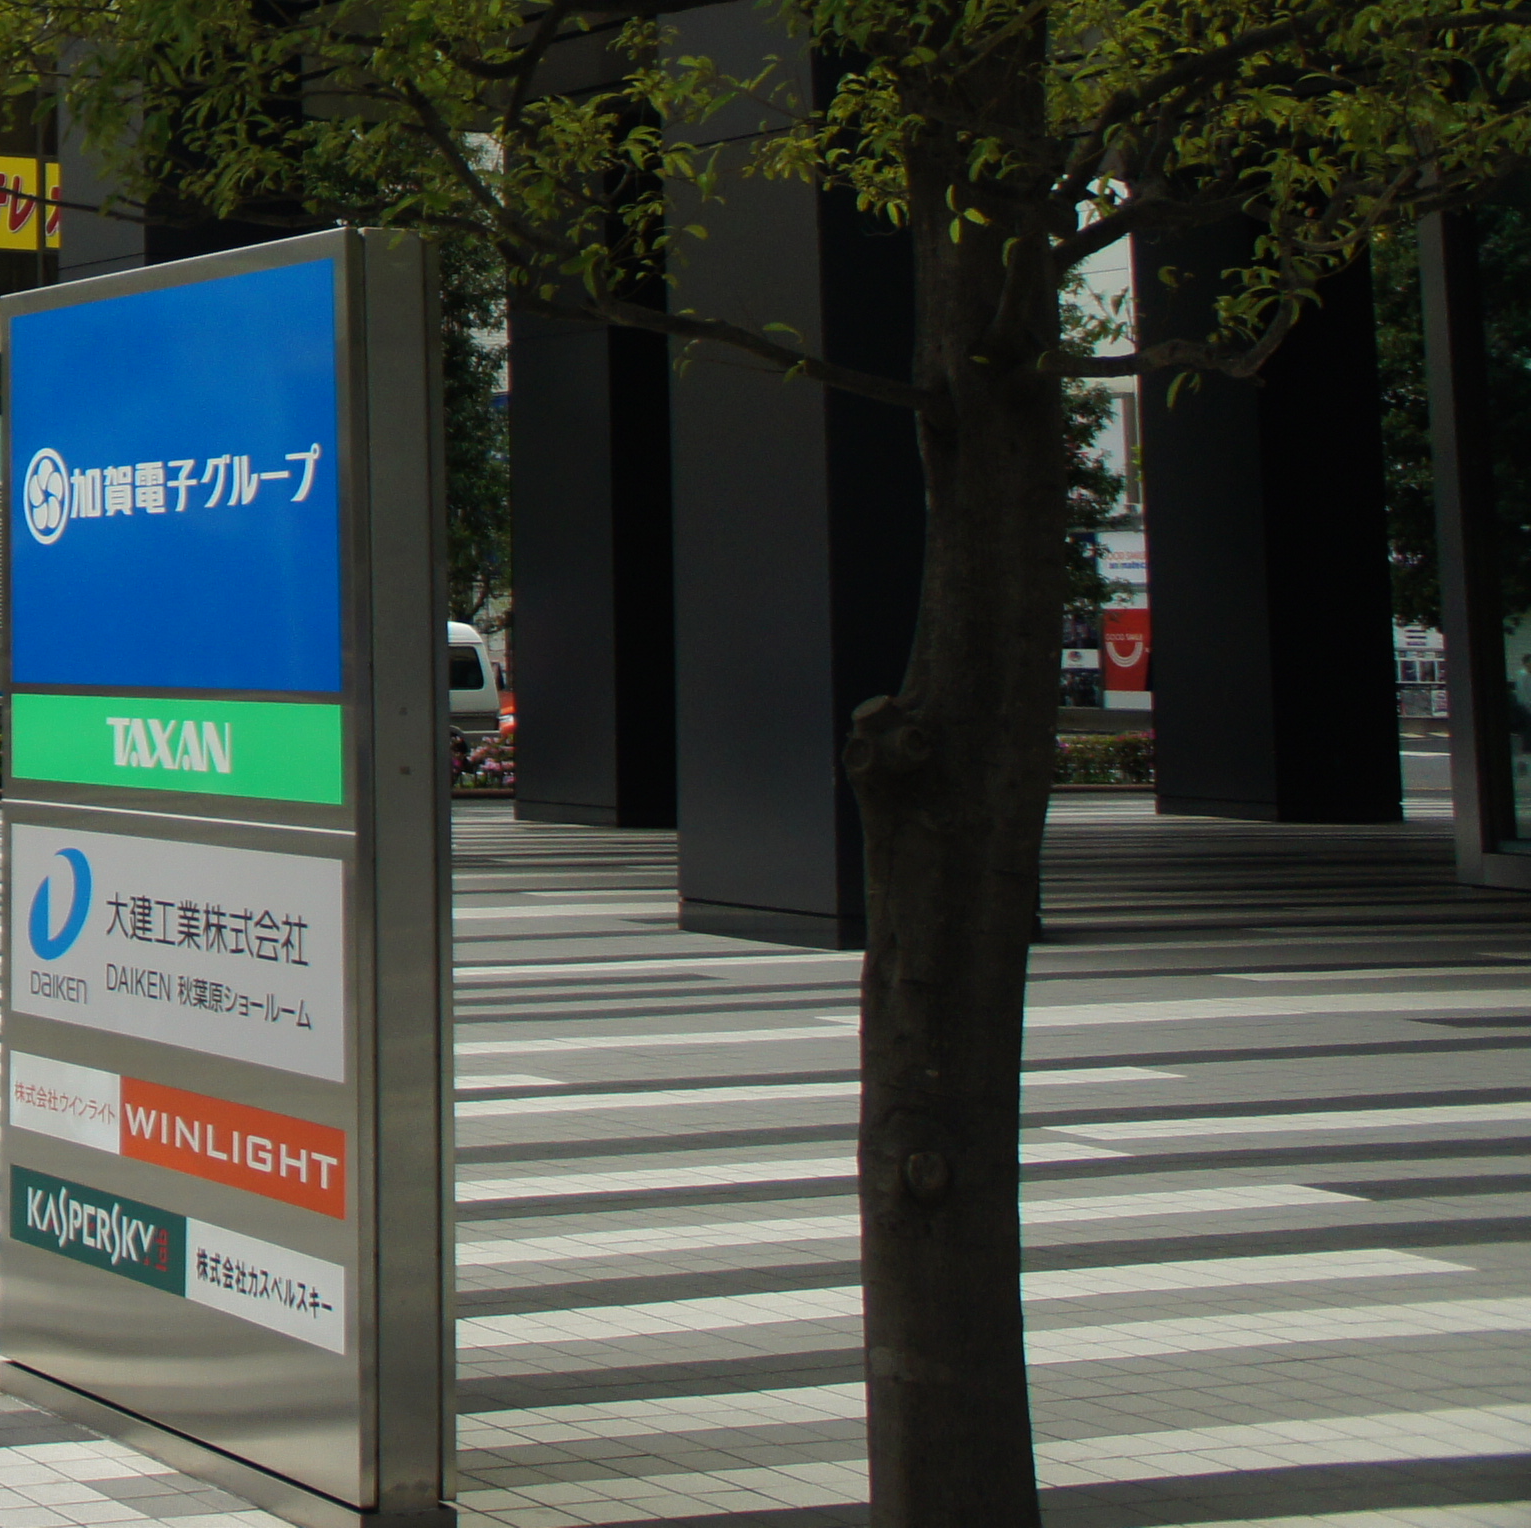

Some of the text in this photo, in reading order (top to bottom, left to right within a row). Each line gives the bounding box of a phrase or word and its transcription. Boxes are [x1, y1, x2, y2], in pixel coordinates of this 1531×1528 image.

[69, 443, 321, 520] 加賀電子グループ
[105, 716, 232, 774] TAXAN
[105, 891, 310, 968] 大建工業株式会社
[105, 962, 313, 1031] DAIKEN 秋葉原ショールーム
[13, 1081, 116, 1125] 株式会社ウインライト
[124, 1102, 338, 1191] WINLIGHT
[26, 1185, 155, 1267] KASPERSKY
[196, 1246, 334, 1319] 株式会社カスペルスキー
